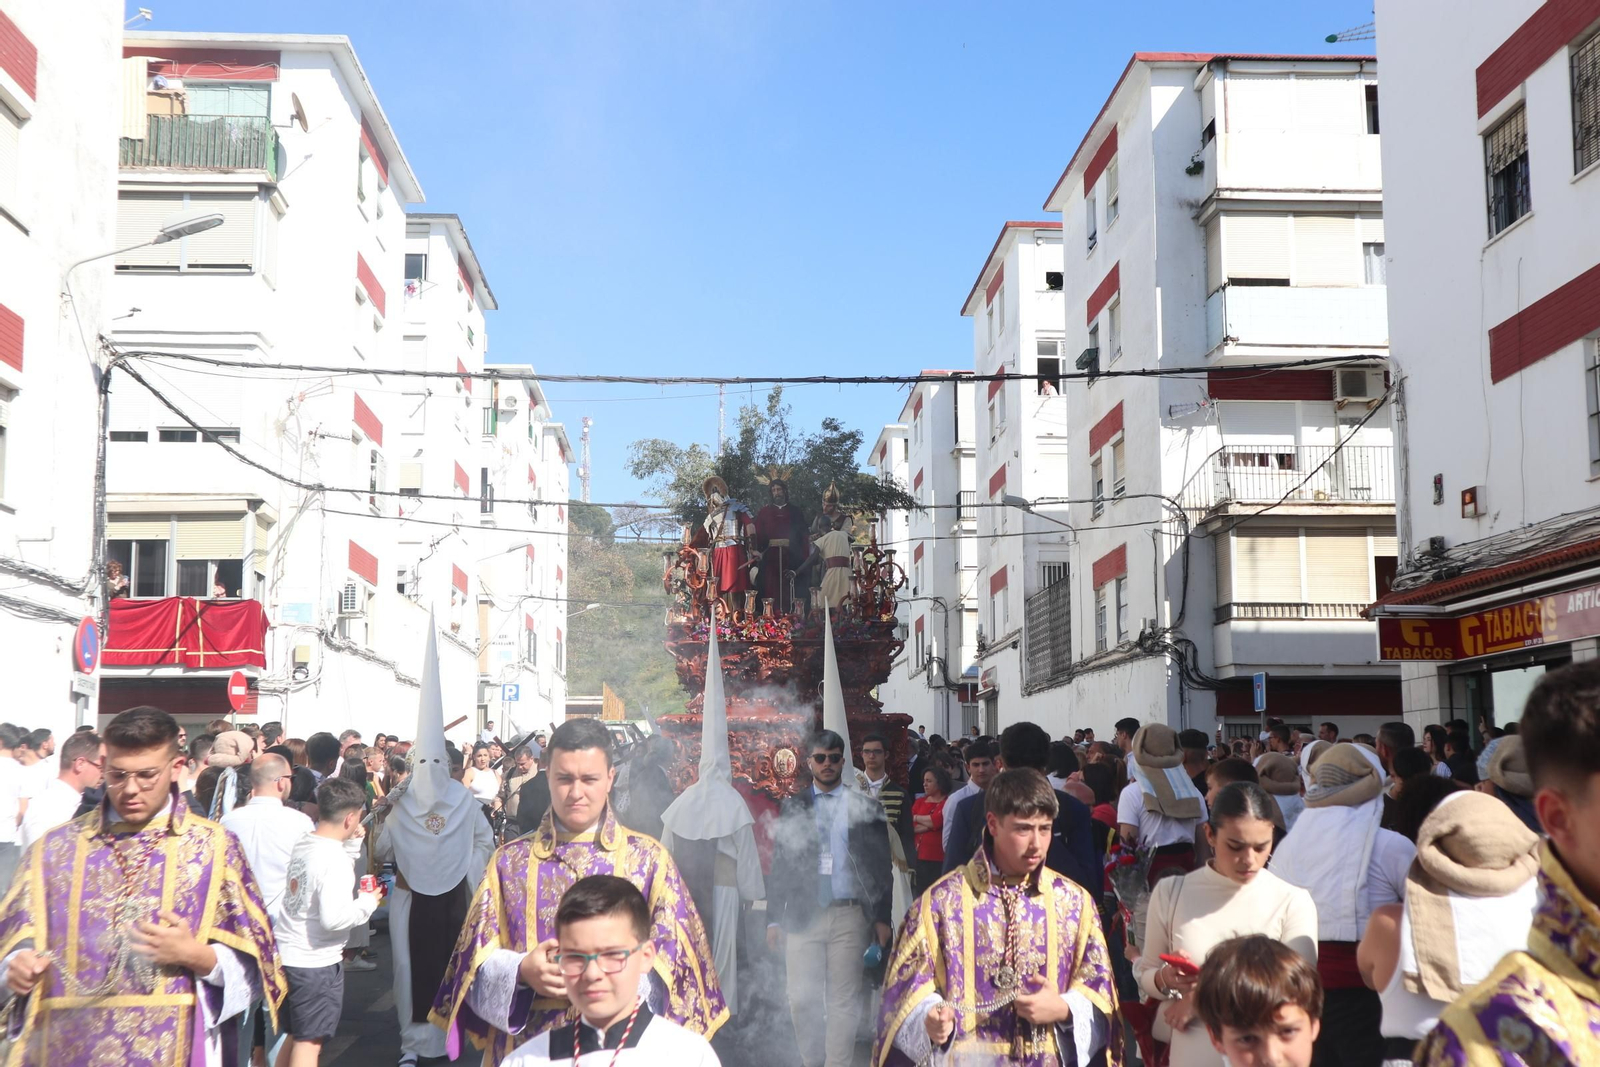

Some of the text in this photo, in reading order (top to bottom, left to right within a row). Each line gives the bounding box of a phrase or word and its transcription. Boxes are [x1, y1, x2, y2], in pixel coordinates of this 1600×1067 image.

[1484, 597, 1557, 643] TABACOS
[1384, 647, 1453, 660] TABACOS
[504, 685, 517, 700] P
